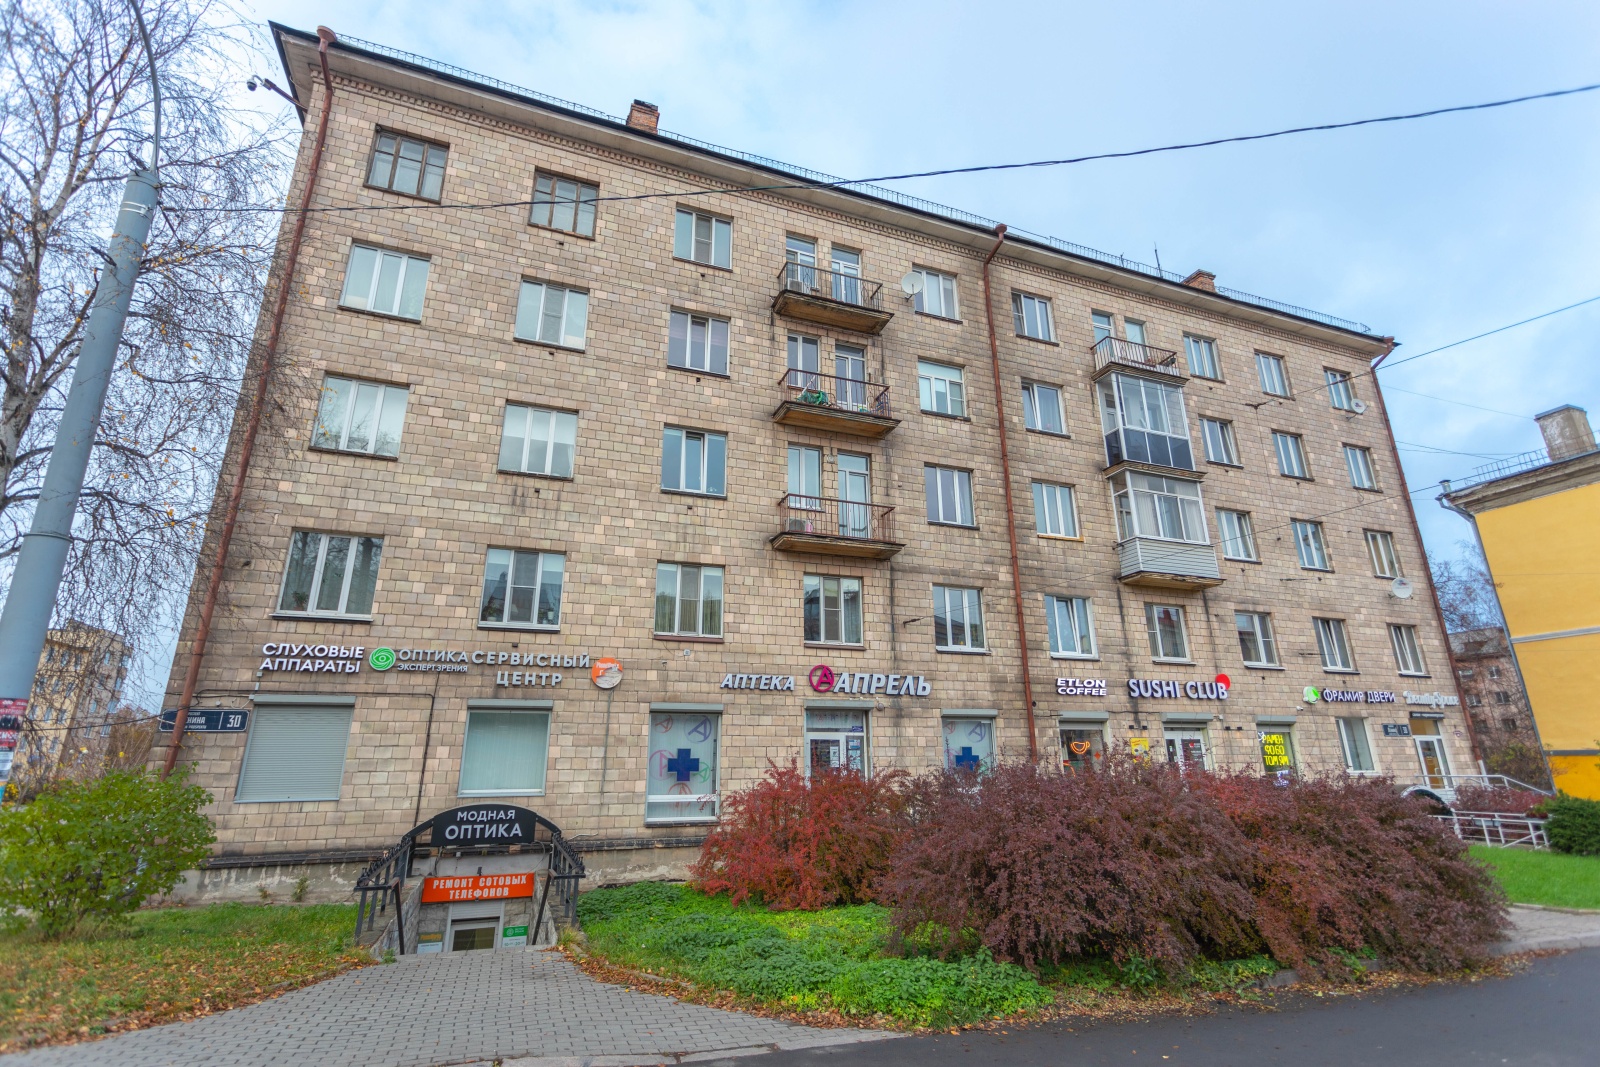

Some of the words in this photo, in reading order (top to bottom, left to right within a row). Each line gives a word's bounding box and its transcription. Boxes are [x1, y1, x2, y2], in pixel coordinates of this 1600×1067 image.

[262, 643, 364, 658] СЛУХОВЫЕ
[399, 649, 468, 662] ОПТИКА
[259, 657, 361, 673] АППАРАТЫ
[472, 651, 590, 668] СЕРВИСНЫЙ
[397, 664, 436, 672] ЭКСПЕРТ
[436, 664, 468, 673] ЗРЕНИЯ
[496, 670, 563, 687] ЦЕНТР
[720, 673, 795, 691] АПТЕКА
[833, 672, 932, 697] АПРЕЛЬ
[1056, 678, 1106, 688] ETLON
[1056, 687, 1107, 696] COFFEE
[1127, 678, 1181, 698] SUSHI
[1184, 681, 1229, 700] CLUB
[1322, 689, 1364, 702] ФРАМИР
[1366, 691, 1396, 703] ДВЕРИ
[186, 716, 206, 724] НИНА
[227, 715, 241, 727] 30
[457, 810, 516, 822] МОДНАЯ
[445, 823, 522, 840] ОПТИКА
[433, 878, 474, 889] РЕМОНТ
[479, 875, 527, 887] СОТОВЫХ
[449, 887, 509, 899] ТЕЛЕФОНОВ
